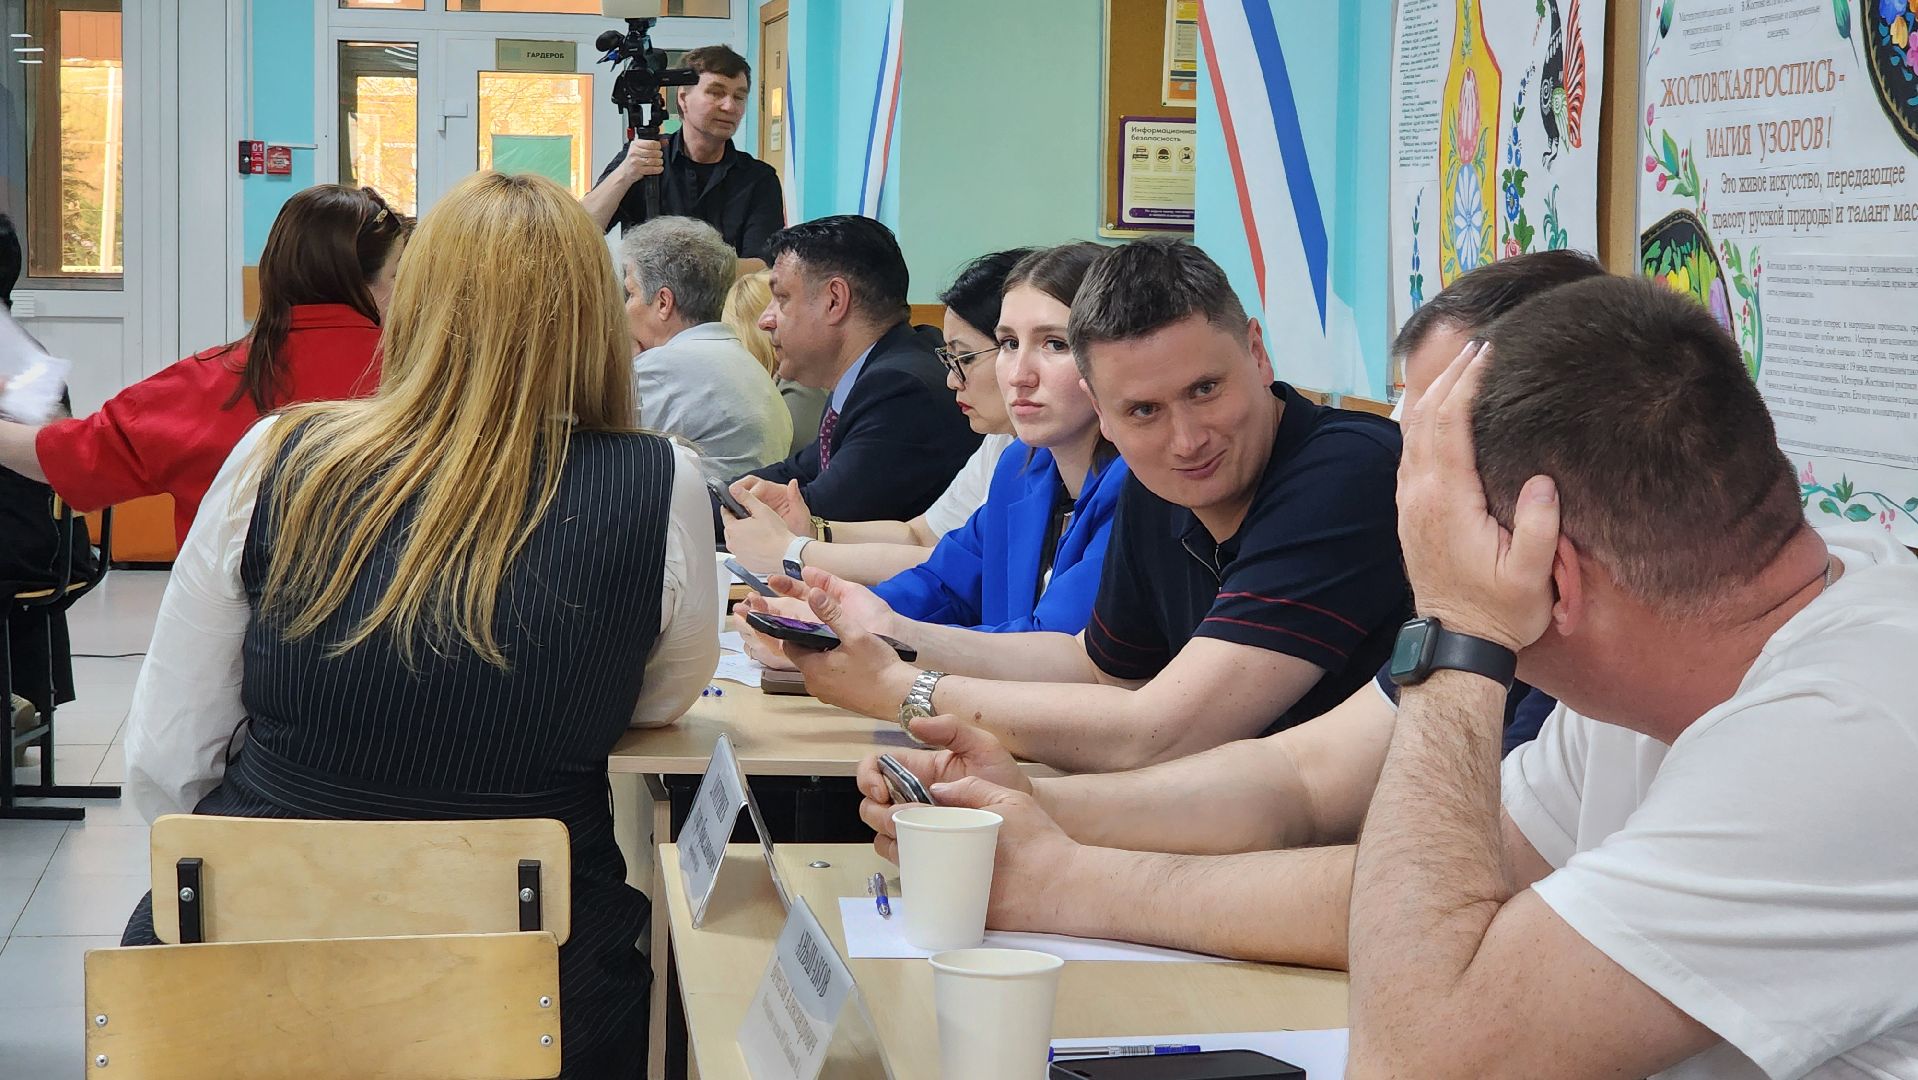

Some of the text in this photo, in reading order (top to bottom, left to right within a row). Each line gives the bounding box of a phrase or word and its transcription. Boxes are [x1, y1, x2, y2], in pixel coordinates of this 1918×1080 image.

[526, 51, 564, 59] ГАРДЕРОБ
[252, 143, 263, 152] 01
[1706, 124, 1752, 158] МАГИЯ
[1721, 165, 1905, 197] Это живое искусство, передающее
[1712, 211, 1747, 234] красоту
[1749, 204, 1784, 234] русской
[1787, 208, 1832, 232] природы
[1836, 205, 1844, 223] и
[1847, 204, 1890, 223] талант
